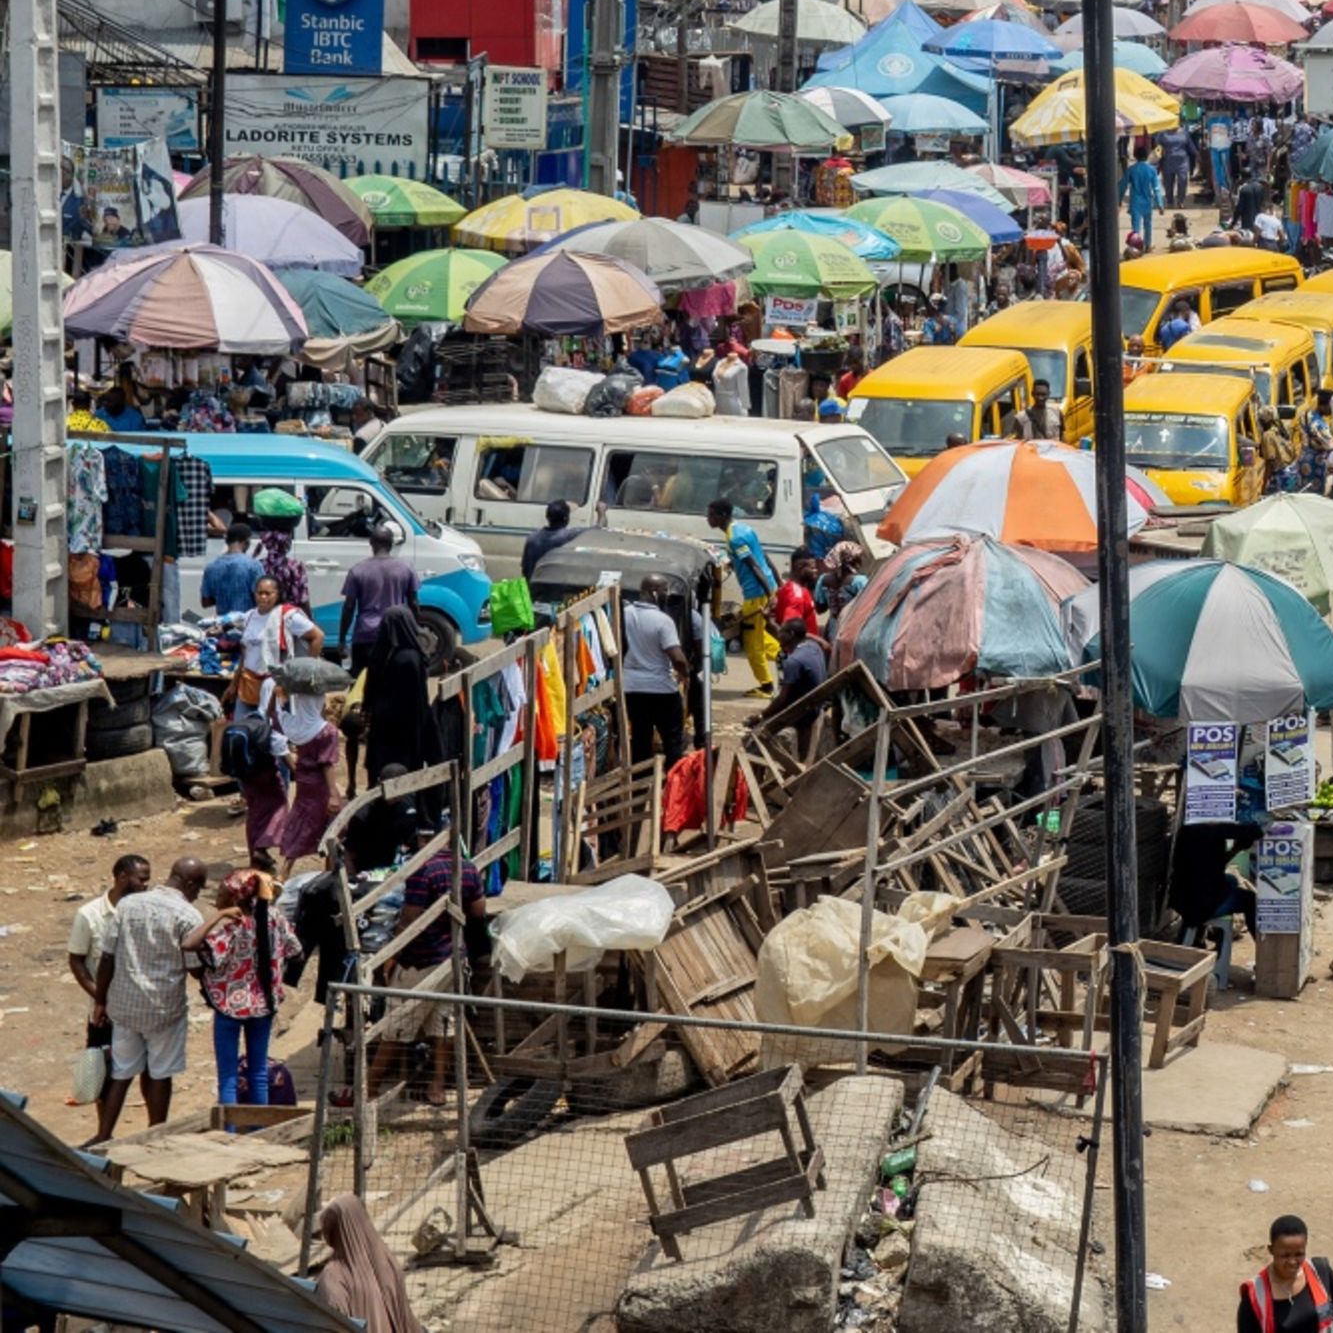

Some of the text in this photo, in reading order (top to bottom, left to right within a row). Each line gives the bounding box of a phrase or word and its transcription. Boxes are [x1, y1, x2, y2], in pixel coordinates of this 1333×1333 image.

[301, 13, 365, 31] Stanbic
[313, 32, 352, 47] IBTC
[310, 50, 353, 65] Bank
[511, 73, 541, 85] SCHOOL
[226, 130, 413, 146] LADORITE SYSTEMS
[1272, 716, 1307, 732] POS
[1192, 727, 1235, 742] POS
[1263, 840, 1302, 856] POS
